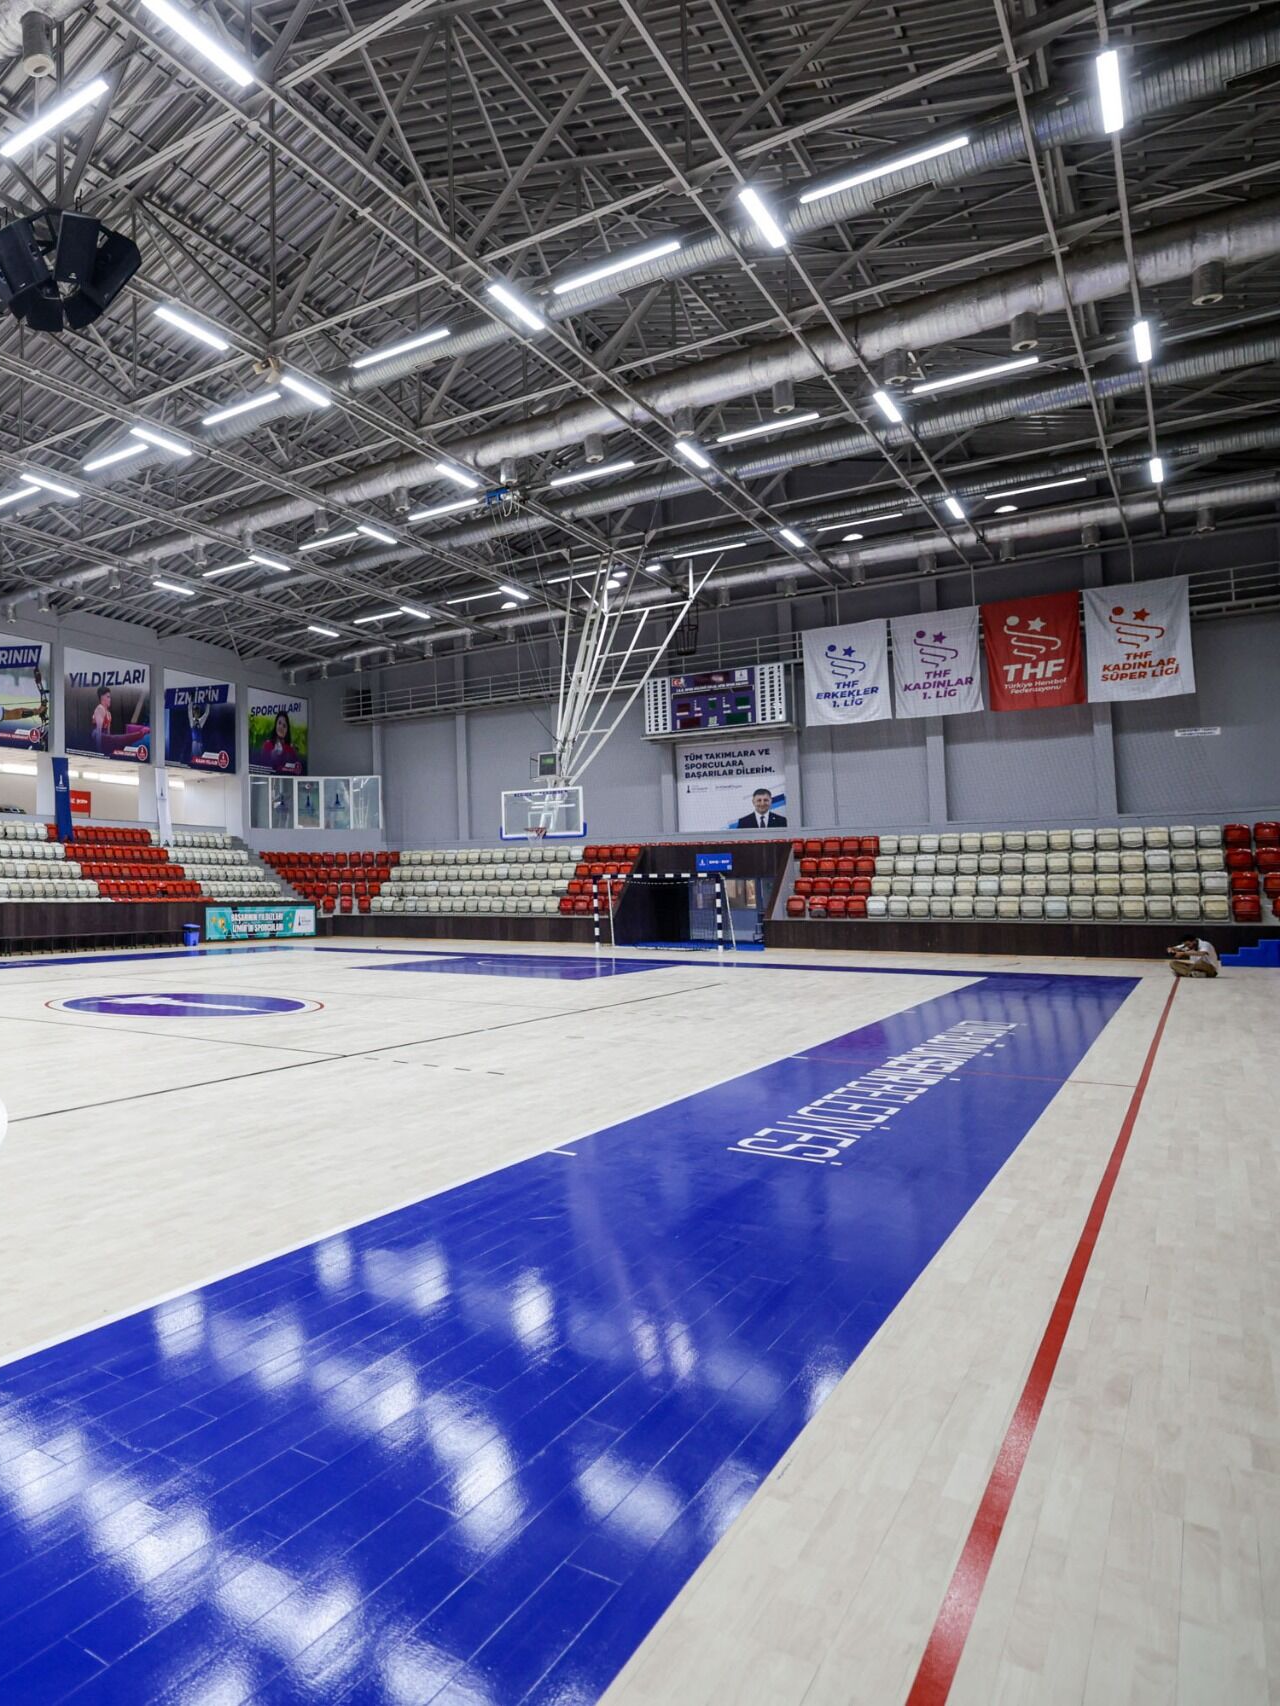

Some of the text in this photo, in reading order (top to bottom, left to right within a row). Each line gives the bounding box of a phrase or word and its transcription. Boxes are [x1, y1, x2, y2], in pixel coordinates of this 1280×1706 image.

[1124, 650, 1152, 660] THF
[1003, 658, 1065, 682] THF
[1102, 657, 1176, 672] KADINLAR
[70, 669, 146, 688] YILDIZLARI
[925, 669, 951, 679] THF
[1101, 664, 1179, 682] SÜPER LİGİ
[835, 680, 859, 690] THF
[903, 676, 974, 692] KADINLAR
[1004, 677, 1067, 690] Türkiye Hentbol
[1010, 685, 1061, 695] Federasyonu
[816, 686, 879, 700] ERKEKLER
[922, 688, 957, 700] 1. LİG
[832, 696, 863, 708] 1. LİG
[250, 702, 301, 717] SPORCULARI
[684, 748, 770, 761] TÜM TAKIMLARA VE
[685, 760, 744, 770] SPORCULARA
[685, 764, 775, 779] BAŞARILAR DİLERİM.
[727, 1080, 929, 1166] BELEDİYESİ
